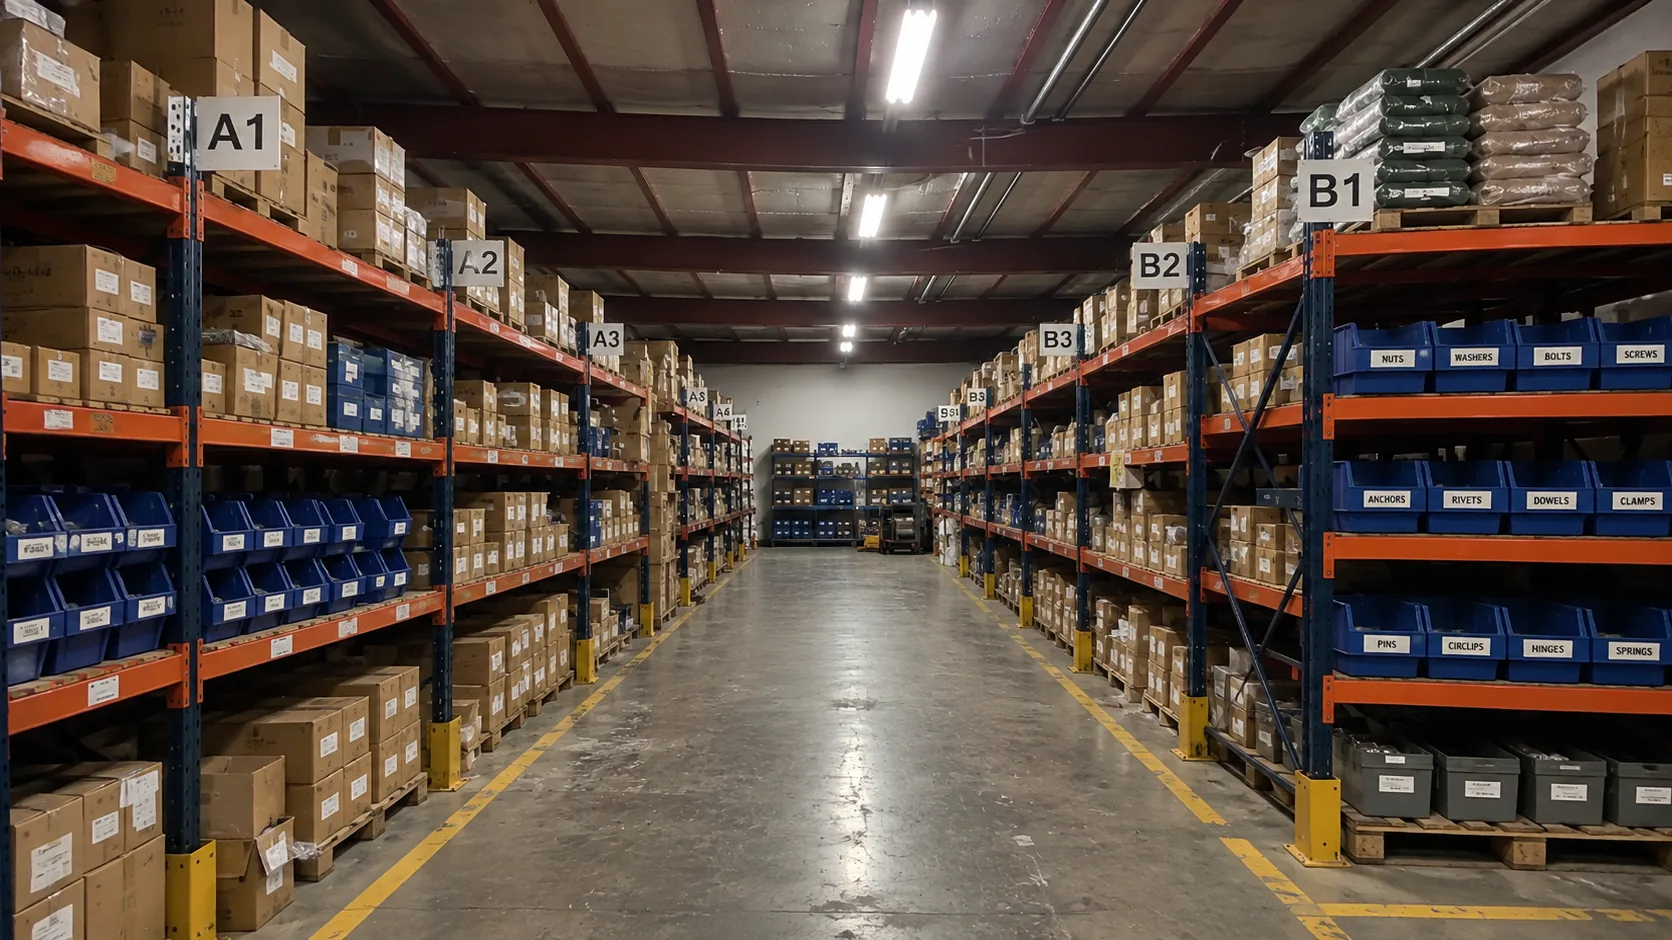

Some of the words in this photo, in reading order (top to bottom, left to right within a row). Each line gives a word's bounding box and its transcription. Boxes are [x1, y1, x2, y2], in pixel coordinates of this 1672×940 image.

[207, 112, 263, 151] A1
[1309, 172, 1360, 208] B1
[457, 250, 498, 275] A2
[1140, 252, 1180, 278] B2
[593, 330, 620, 348] A3
[1044, 330, 1073, 348] B3
[1381, 354, 1405, 364] NUTS
[1454, 352, 1493, 362] WASHERS
[1544, 351, 1572, 361] BOLTS
[1624, 349, 1658, 359] SCREWS
[1367, 494, 1406, 504] ANCHORS
[1451, 495, 1483, 505] RIVETS
[1533, 496, 1570, 506] DOWELS
[1620, 496, 1656, 506] CLAMPS
[1377, 639, 1397, 649] PINS
[1448, 641, 1484, 651] CIRCLIPS
[1531, 644, 1565, 654] HINGES
[1615, 646, 1653, 657] SPRINGS
